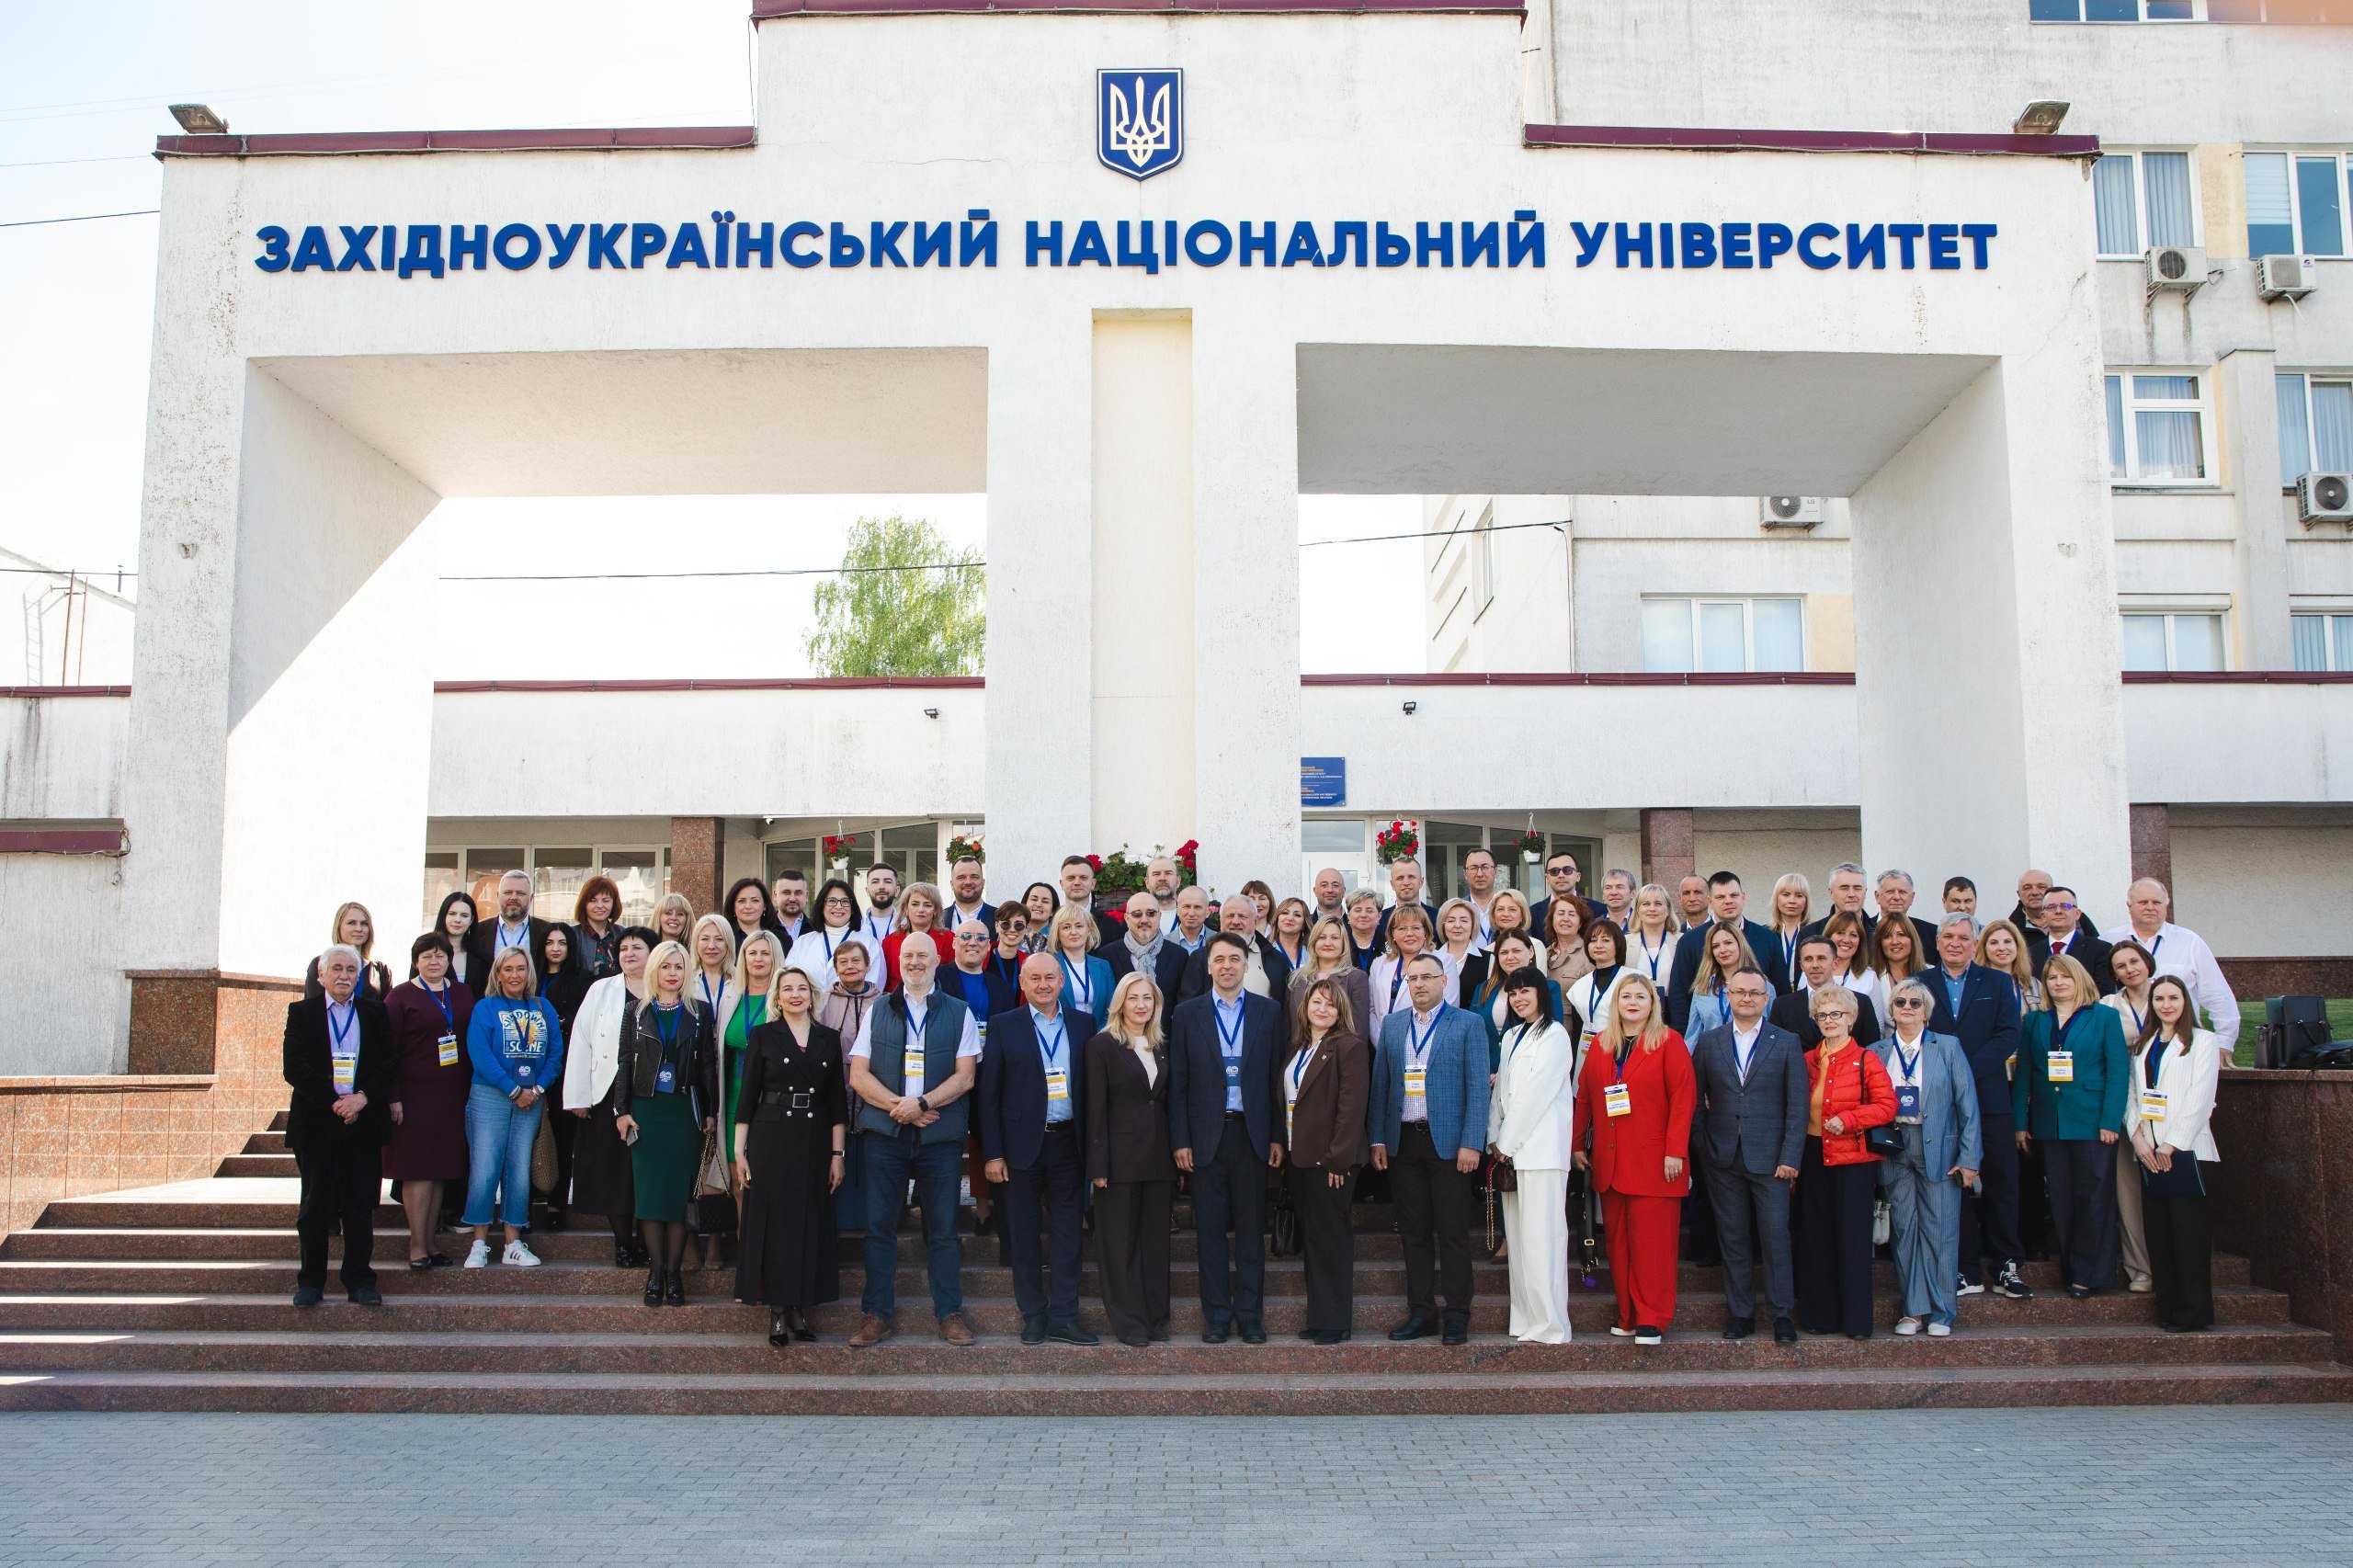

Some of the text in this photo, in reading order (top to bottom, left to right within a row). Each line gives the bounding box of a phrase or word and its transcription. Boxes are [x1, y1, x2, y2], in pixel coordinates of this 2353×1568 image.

[255, 210, 1997, 278] ЗАХІДНОУКРАЇНСЬКИЙ НАЦІОНАЛЬНИЙ УНІВЕРСИТЕТ
[509, 1040, 543, 1052] SCNE
